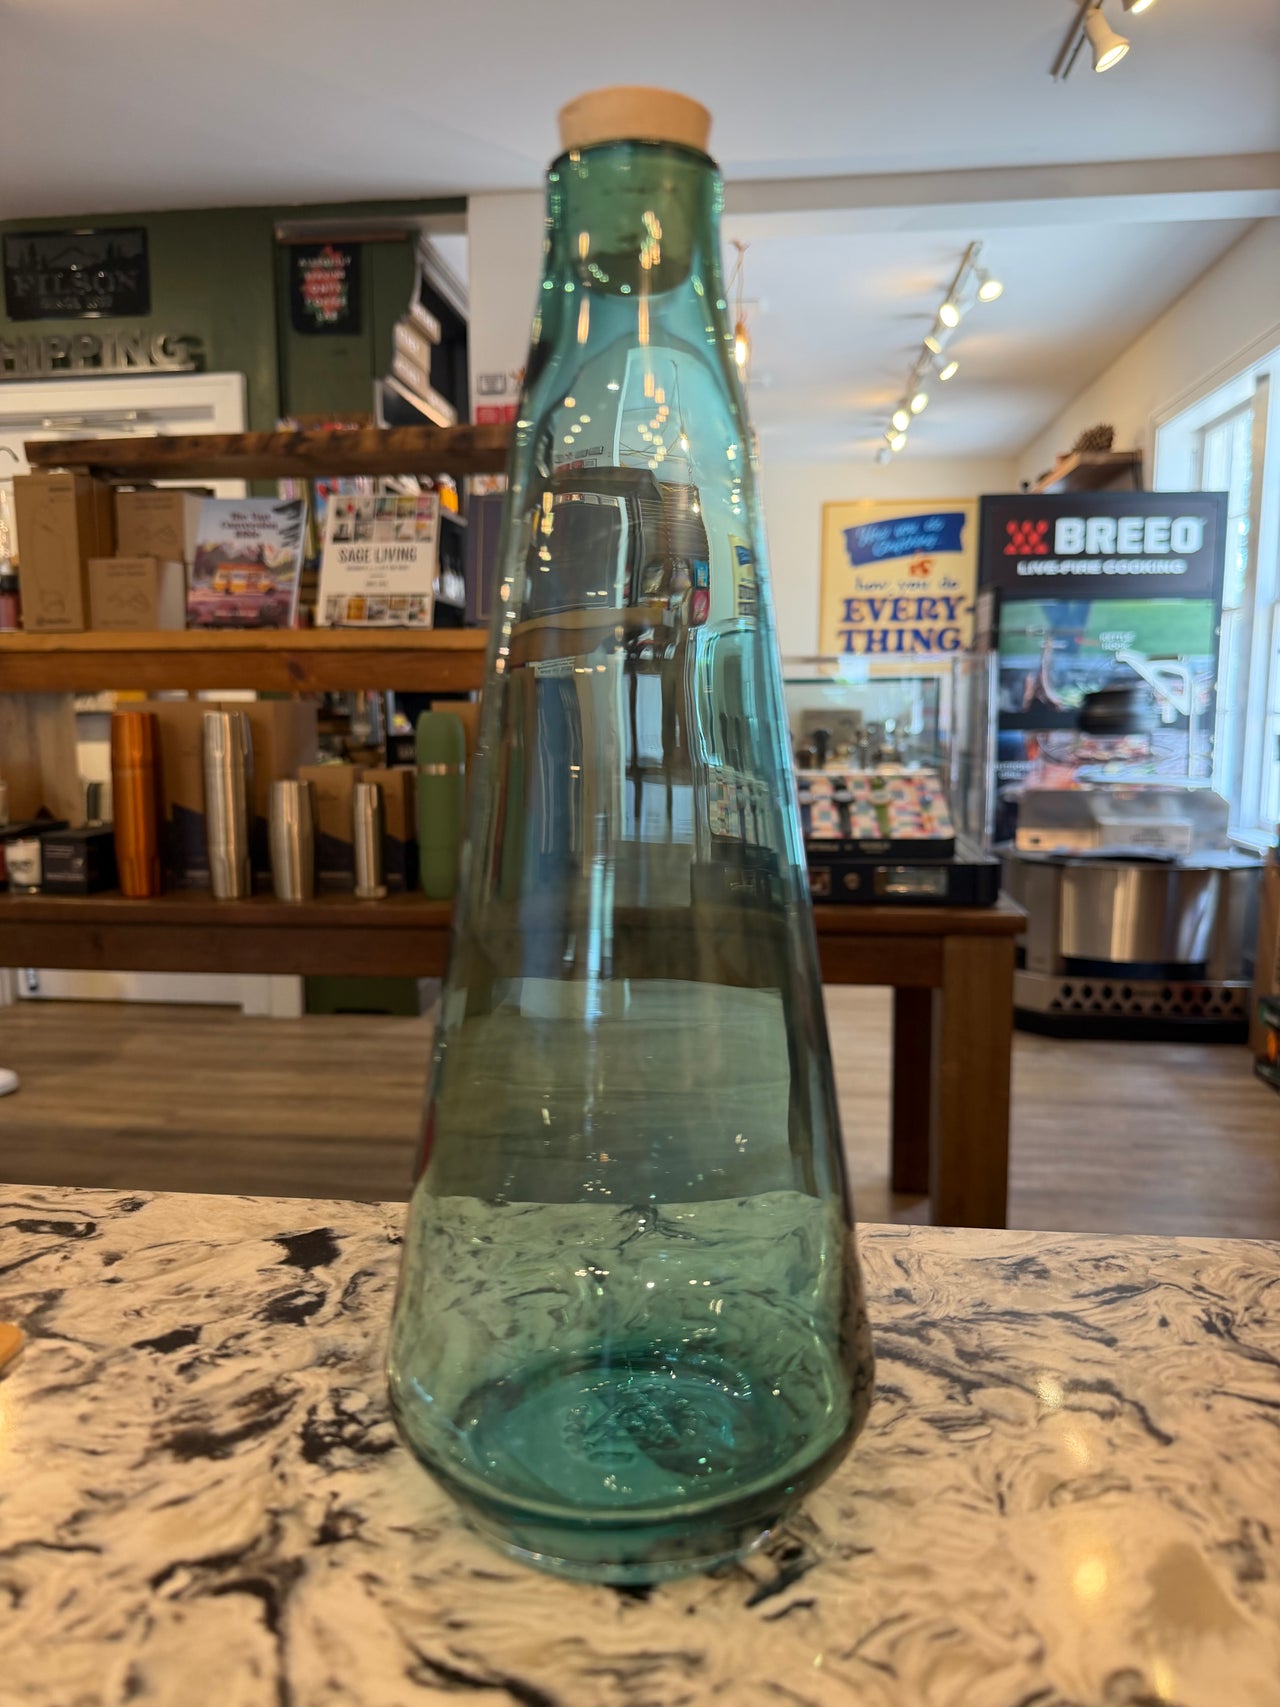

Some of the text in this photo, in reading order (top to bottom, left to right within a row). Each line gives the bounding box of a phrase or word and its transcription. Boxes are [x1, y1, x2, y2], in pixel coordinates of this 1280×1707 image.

[1055, 516, 1204, 555] BREEO
[338, 546, 417, 564] SAGE LIVING
[1102, 559, 1187, 576] COOKING
[855, 577, 887, 591] how
